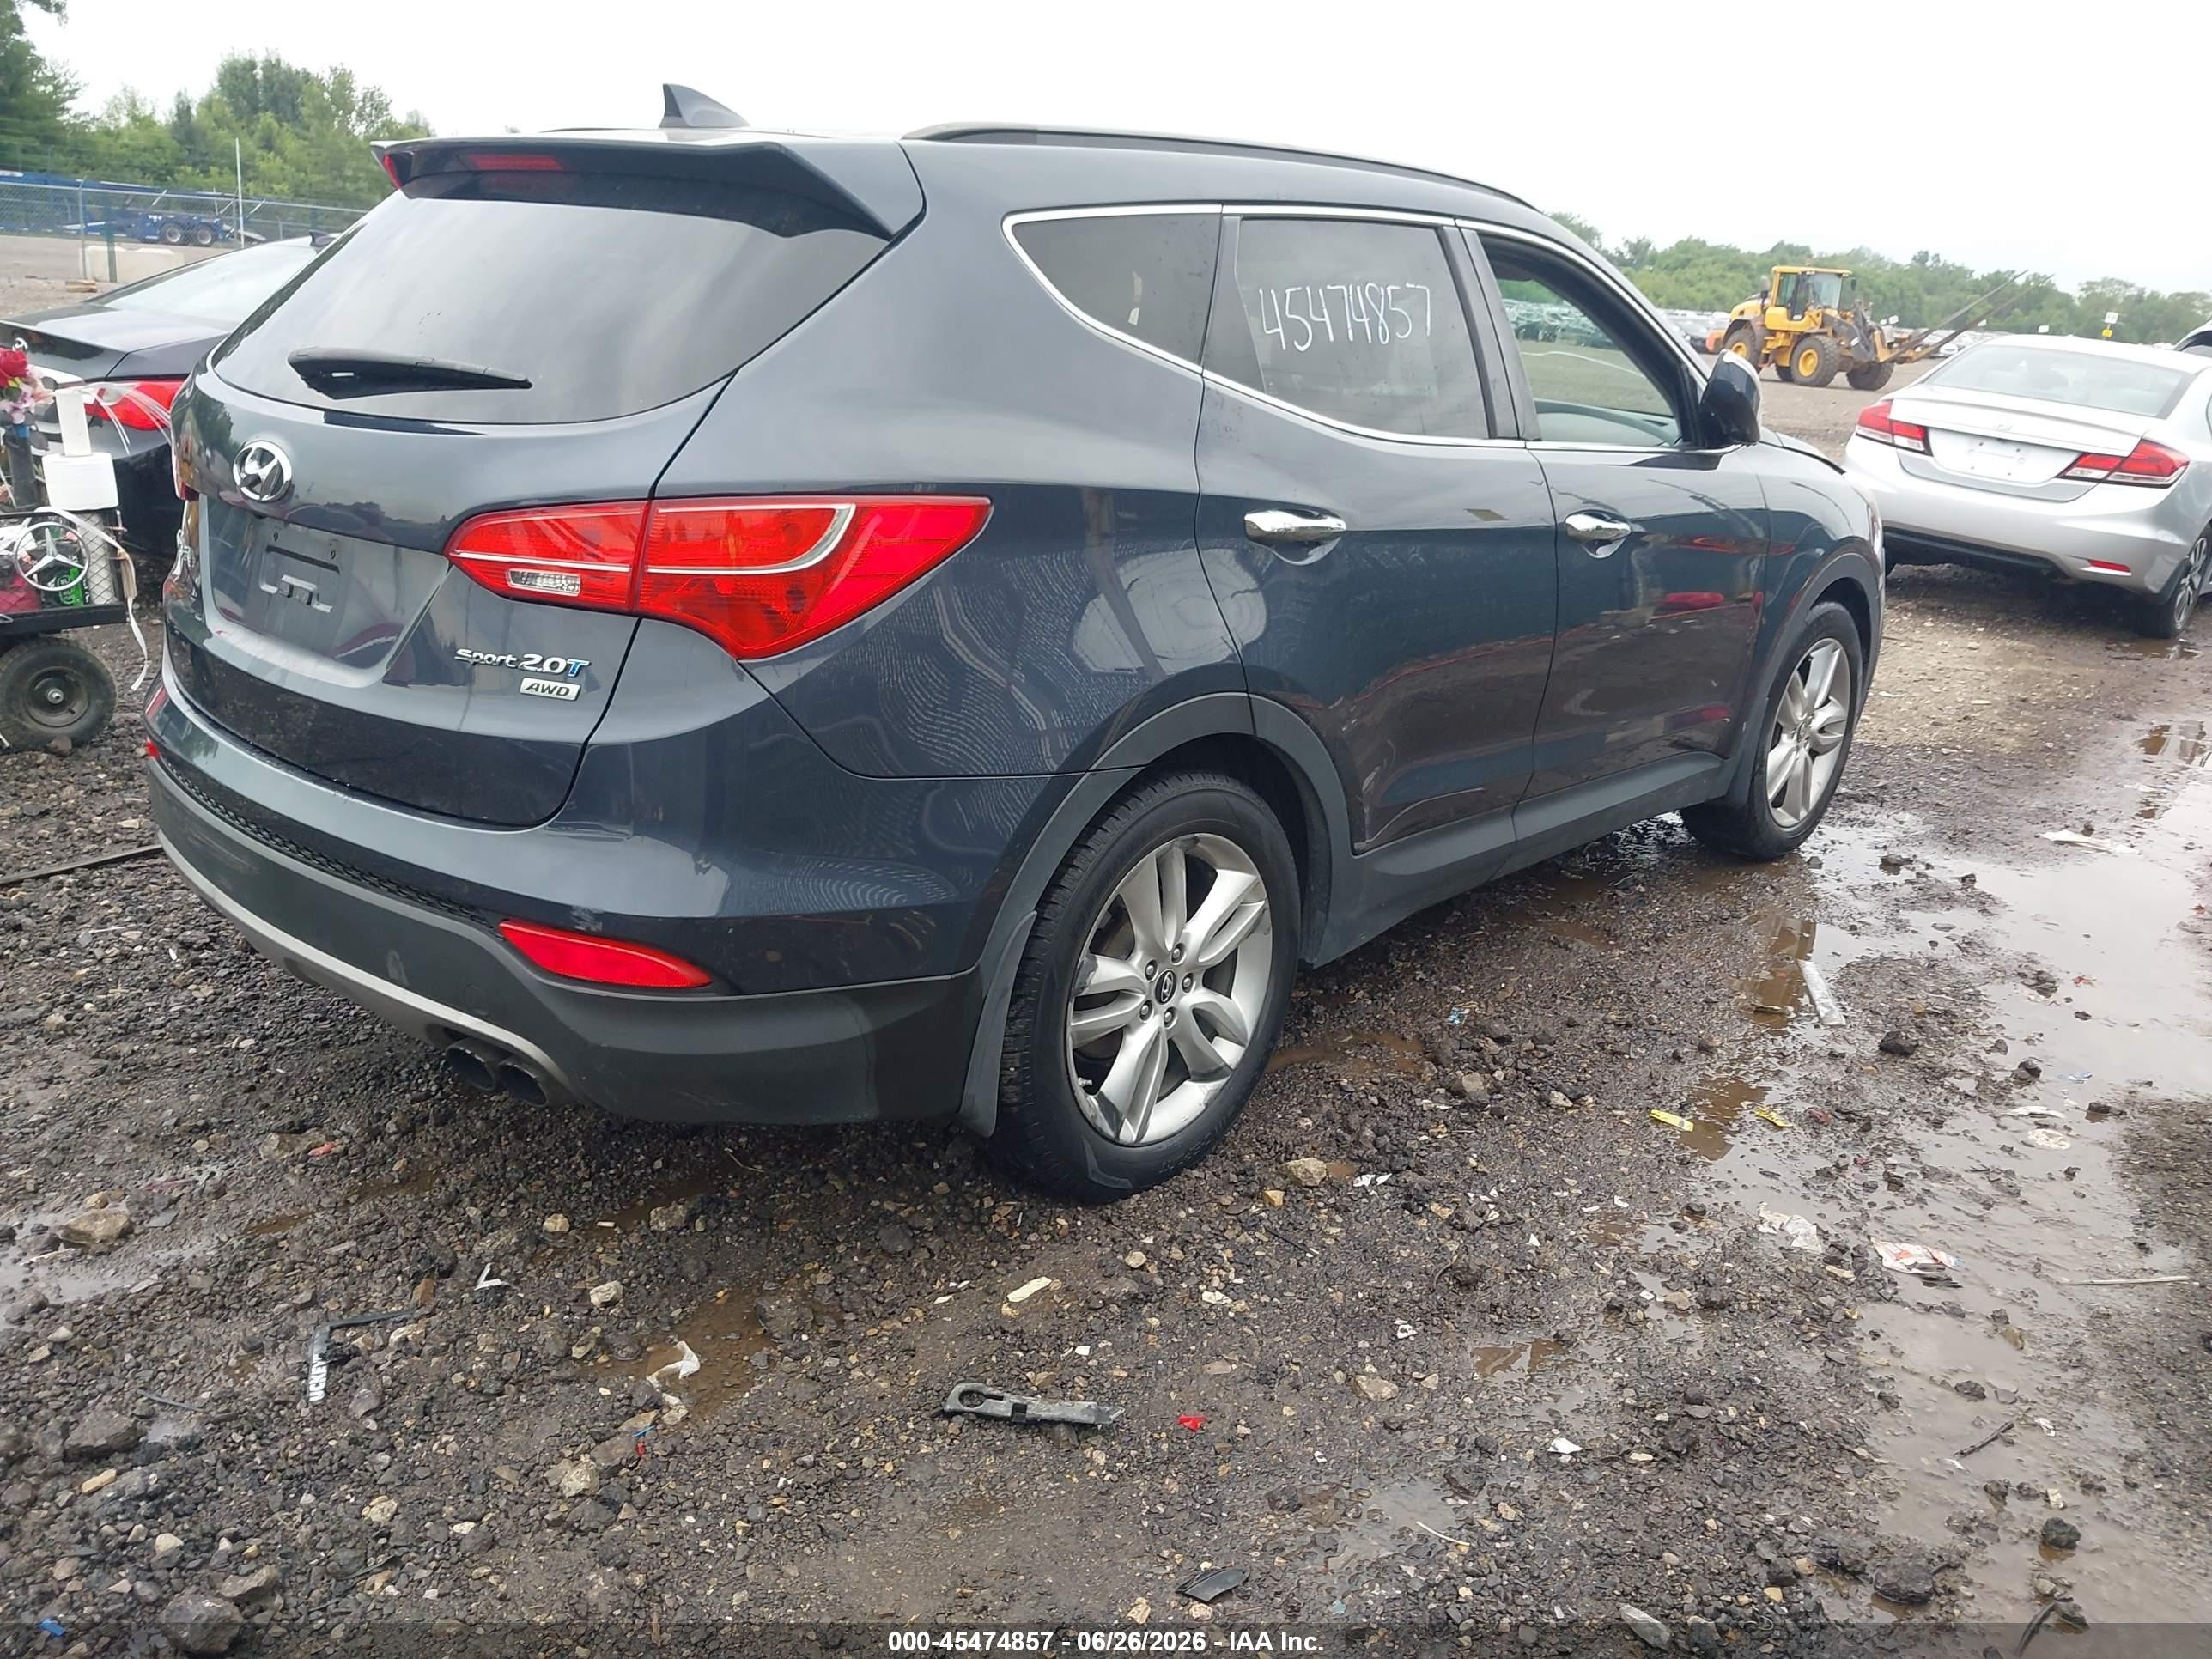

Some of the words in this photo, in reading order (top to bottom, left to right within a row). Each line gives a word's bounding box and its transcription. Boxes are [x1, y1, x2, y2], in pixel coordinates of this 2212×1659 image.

[1259, 282, 1431, 352] 45474857
[454, 648, 518, 669] Sport
[519, 653, 591, 678] 2.0T
[525, 682, 570, 697] AWD
